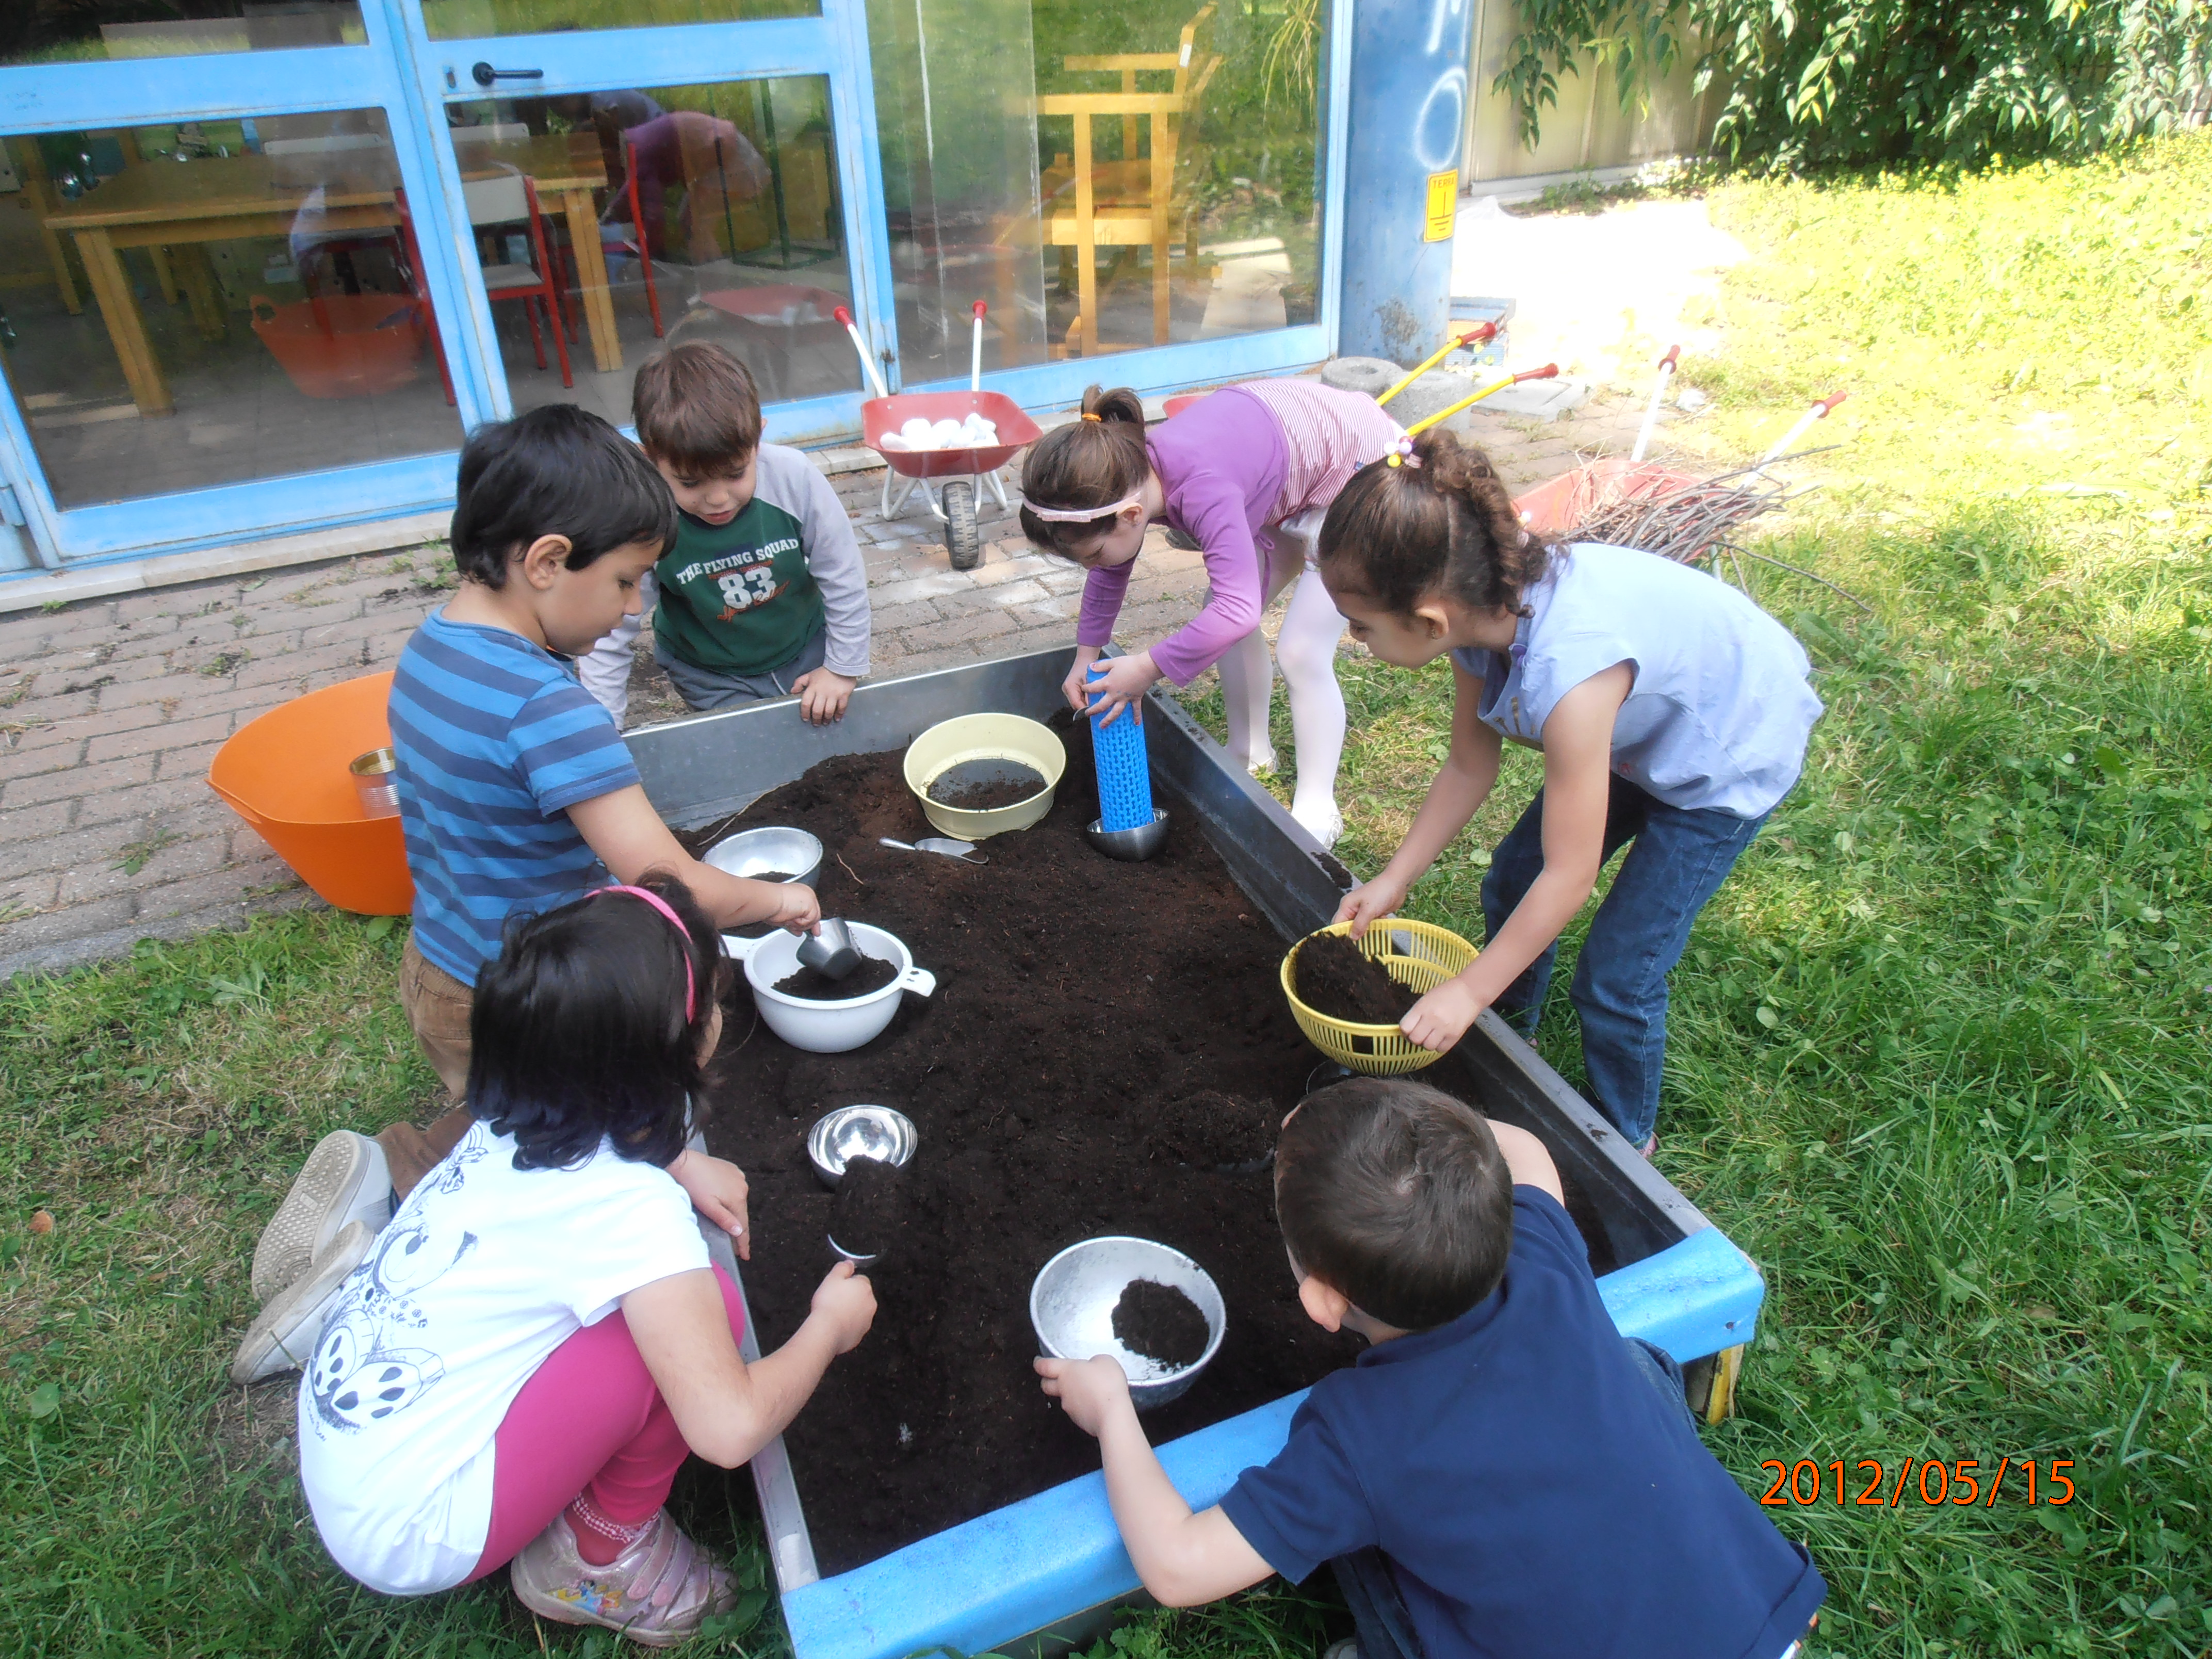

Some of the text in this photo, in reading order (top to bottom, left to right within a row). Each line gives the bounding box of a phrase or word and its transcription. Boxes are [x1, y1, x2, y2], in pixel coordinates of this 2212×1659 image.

[1433, 177, 1454, 189] TERRA
[676, 539, 799, 584] THE FLYING SQUAD
[718, 566, 777, 609] 83
